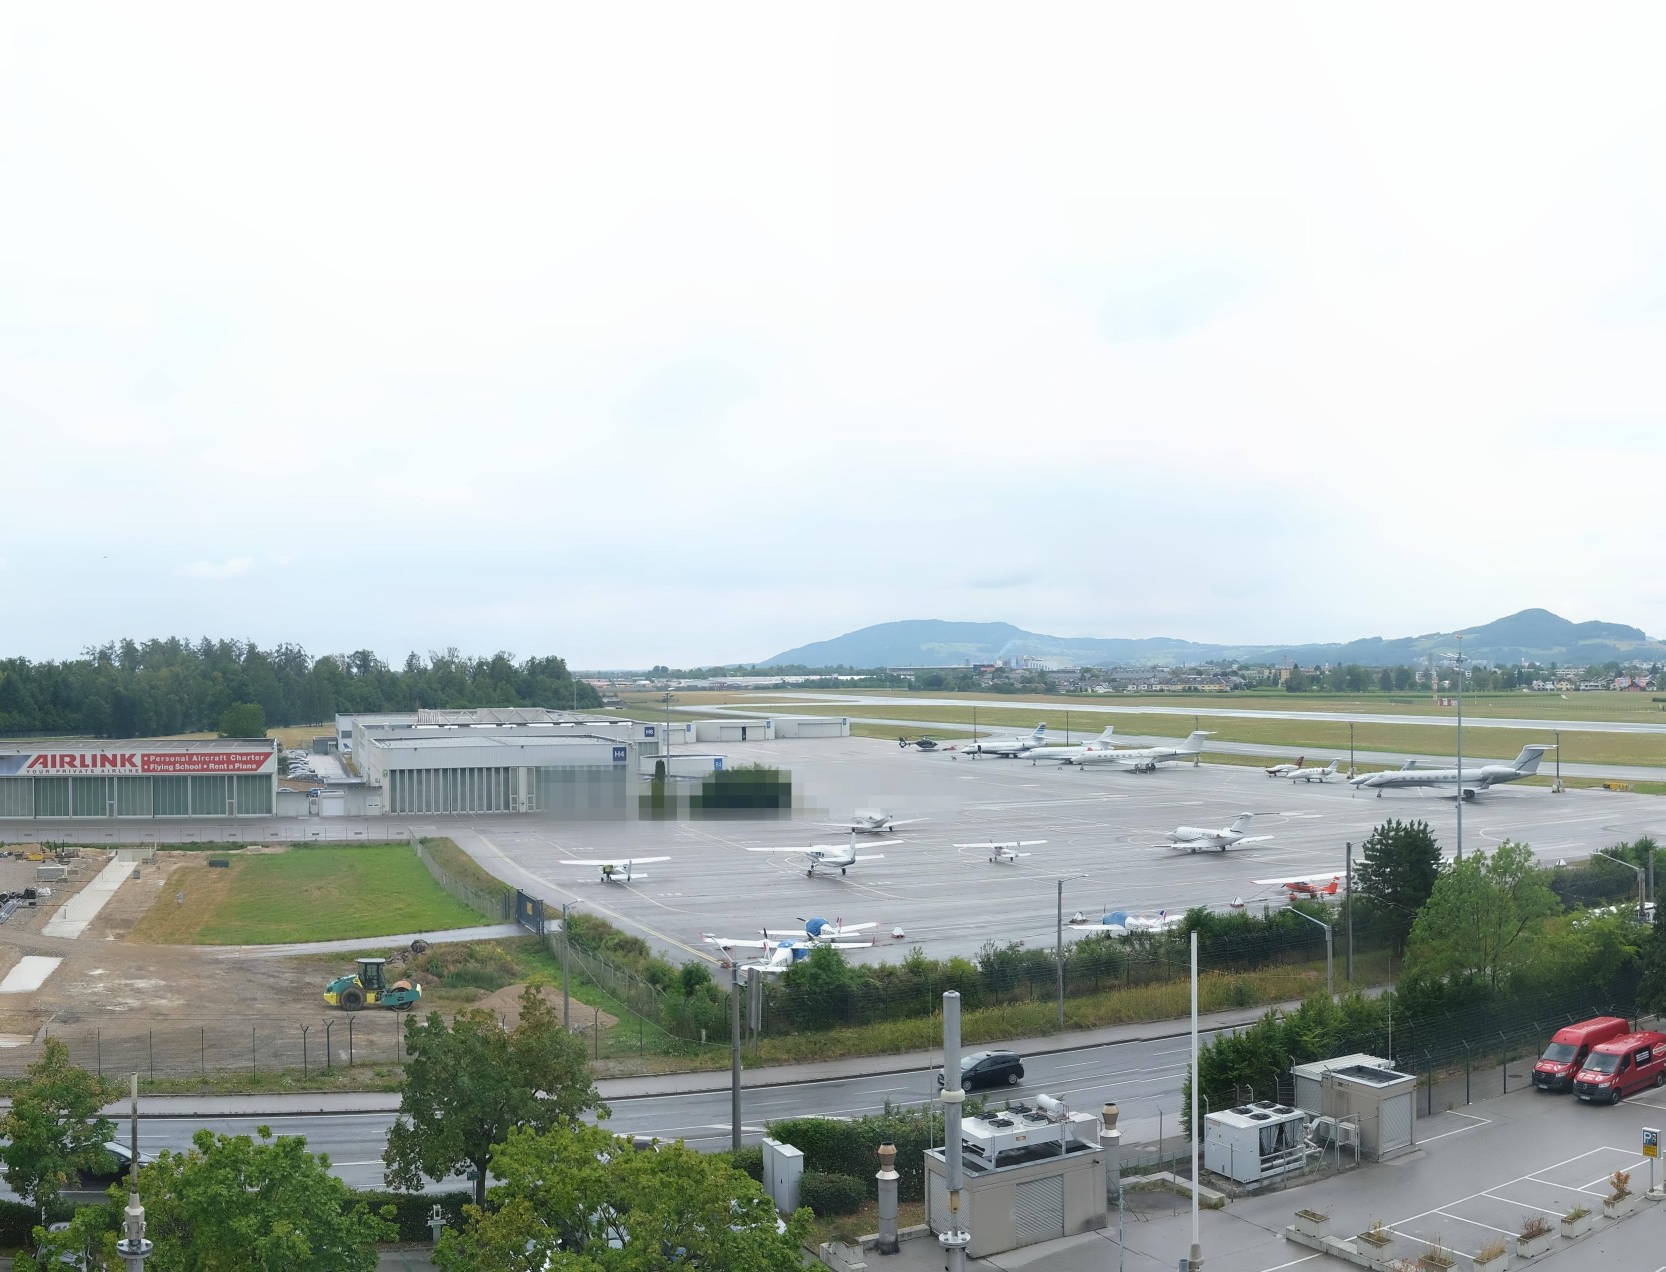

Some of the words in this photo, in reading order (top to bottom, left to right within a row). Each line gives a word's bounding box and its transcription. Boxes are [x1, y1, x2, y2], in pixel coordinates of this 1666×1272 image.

[614, 750, 625, 758] H4
[26, 754, 139, 768] AIRLINK
[150, 763, 174, 771] Flying
[1643, 1131, 1652, 1144] P
